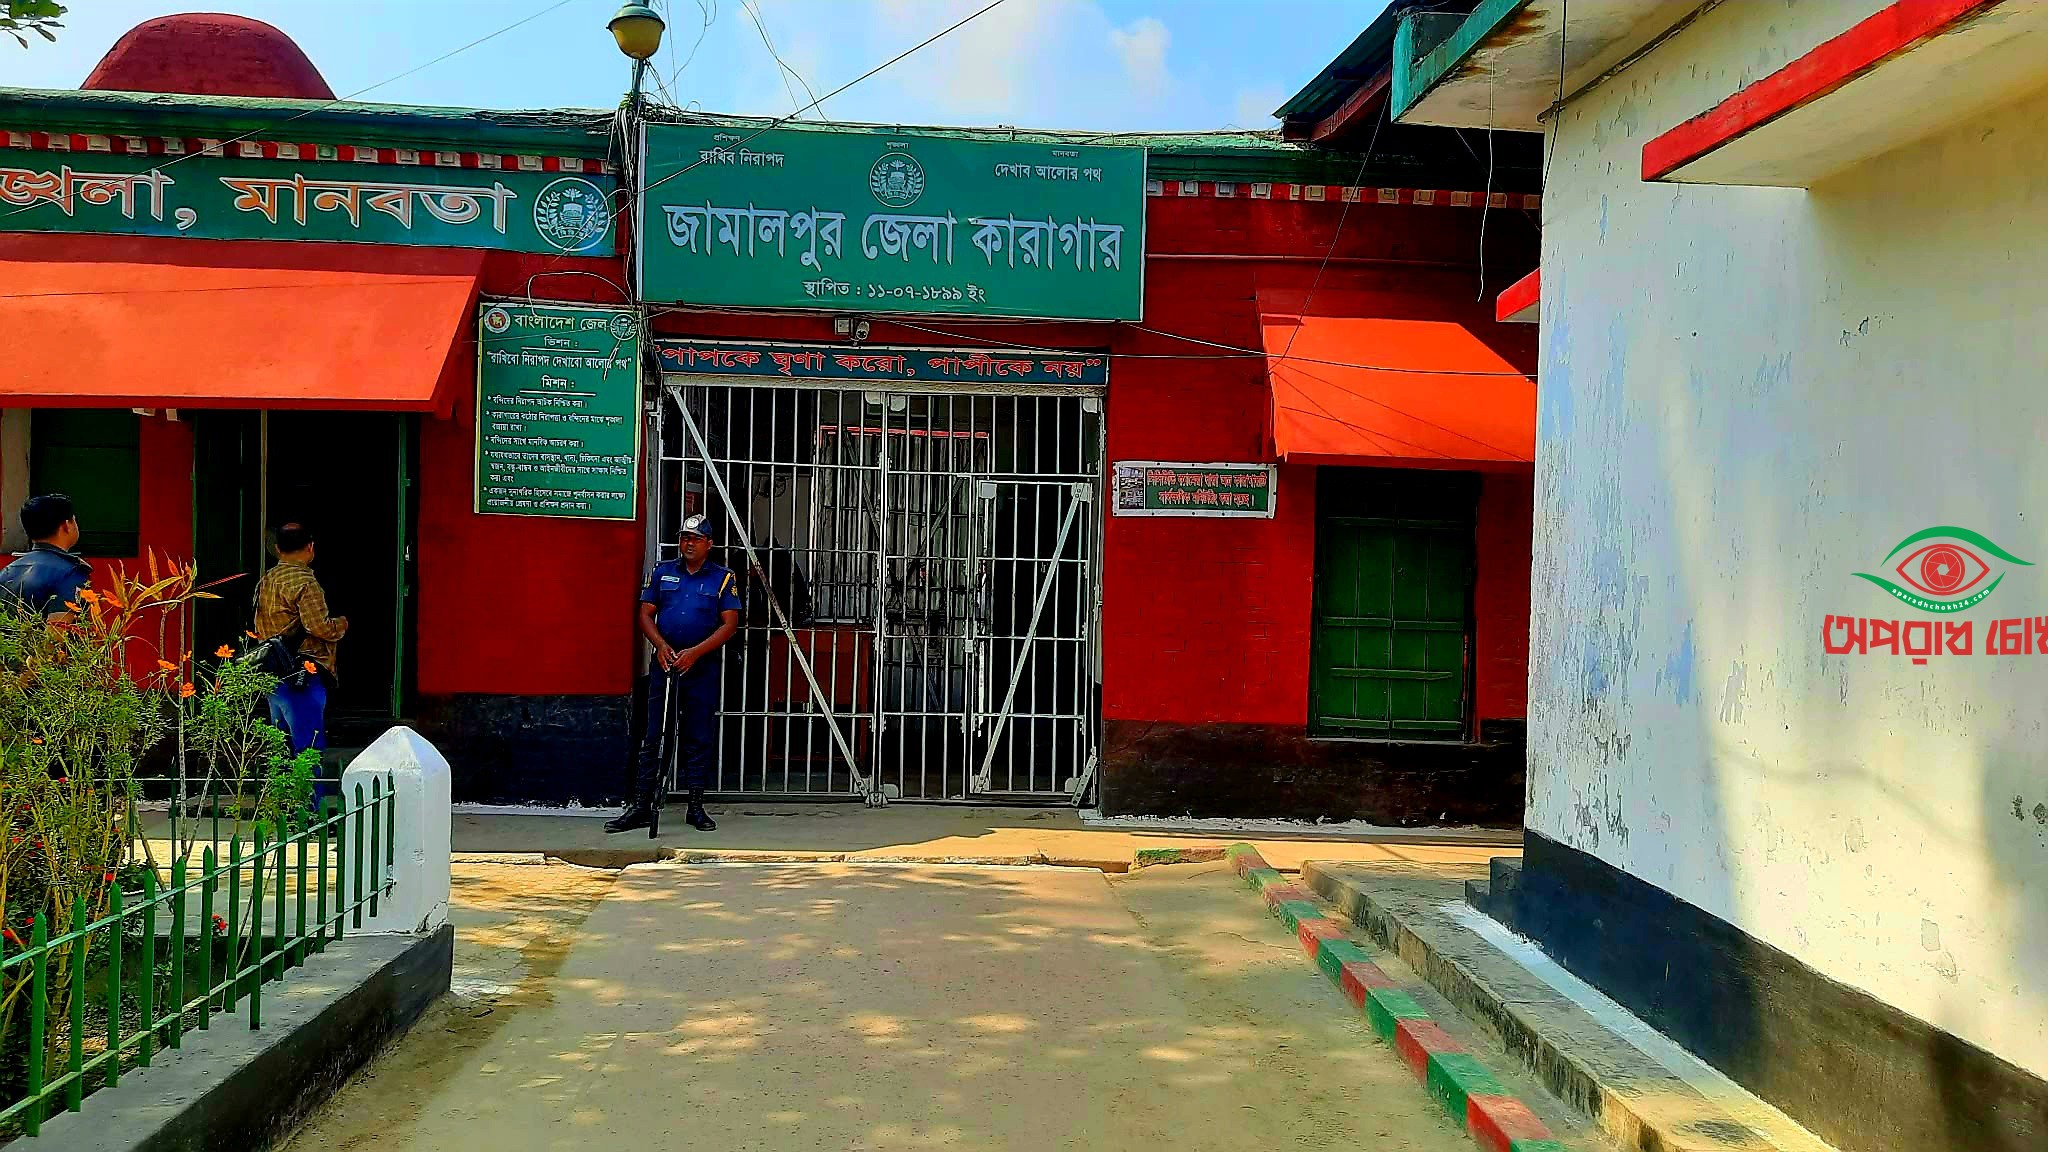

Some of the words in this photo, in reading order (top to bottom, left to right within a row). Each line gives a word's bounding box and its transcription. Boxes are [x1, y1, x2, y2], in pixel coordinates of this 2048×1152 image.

[738, 148, 784, 168] নিরাপদ
[994, 162, 1031, 179] দেখাব
[1034, 165, 1078, 181] আলোর
[1083, 168, 1102, 183] পথ
[218, 173, 518, 235] মানবতা
[661, 199, 848, 272] জামালপুর
[860, 208, 959, 265] জেলা
[968, 212, 1126, 273] কারাগার
[802, 278, 851, 298] স্থাপিত
[866, 282, 963, 302] ১১-০৭-১৮৯৯
[966, 282, 987, 304] ইং
[513, 313, 576, 331] বাংলাদেশ
[580, 318, 609, 332] জেল
[544, 336, 572, 348] ভিশন
[522, 352, 550, 366] নিরাপদ
[552, 356, 583, 368] দেখাবো
[769, 350, 827, 376] ঘৃণা
[834, 354, 916, 377] করো,
[927, 352, 1034, 377] পাপীকে
[540, 375, 568, 390] মিশন
